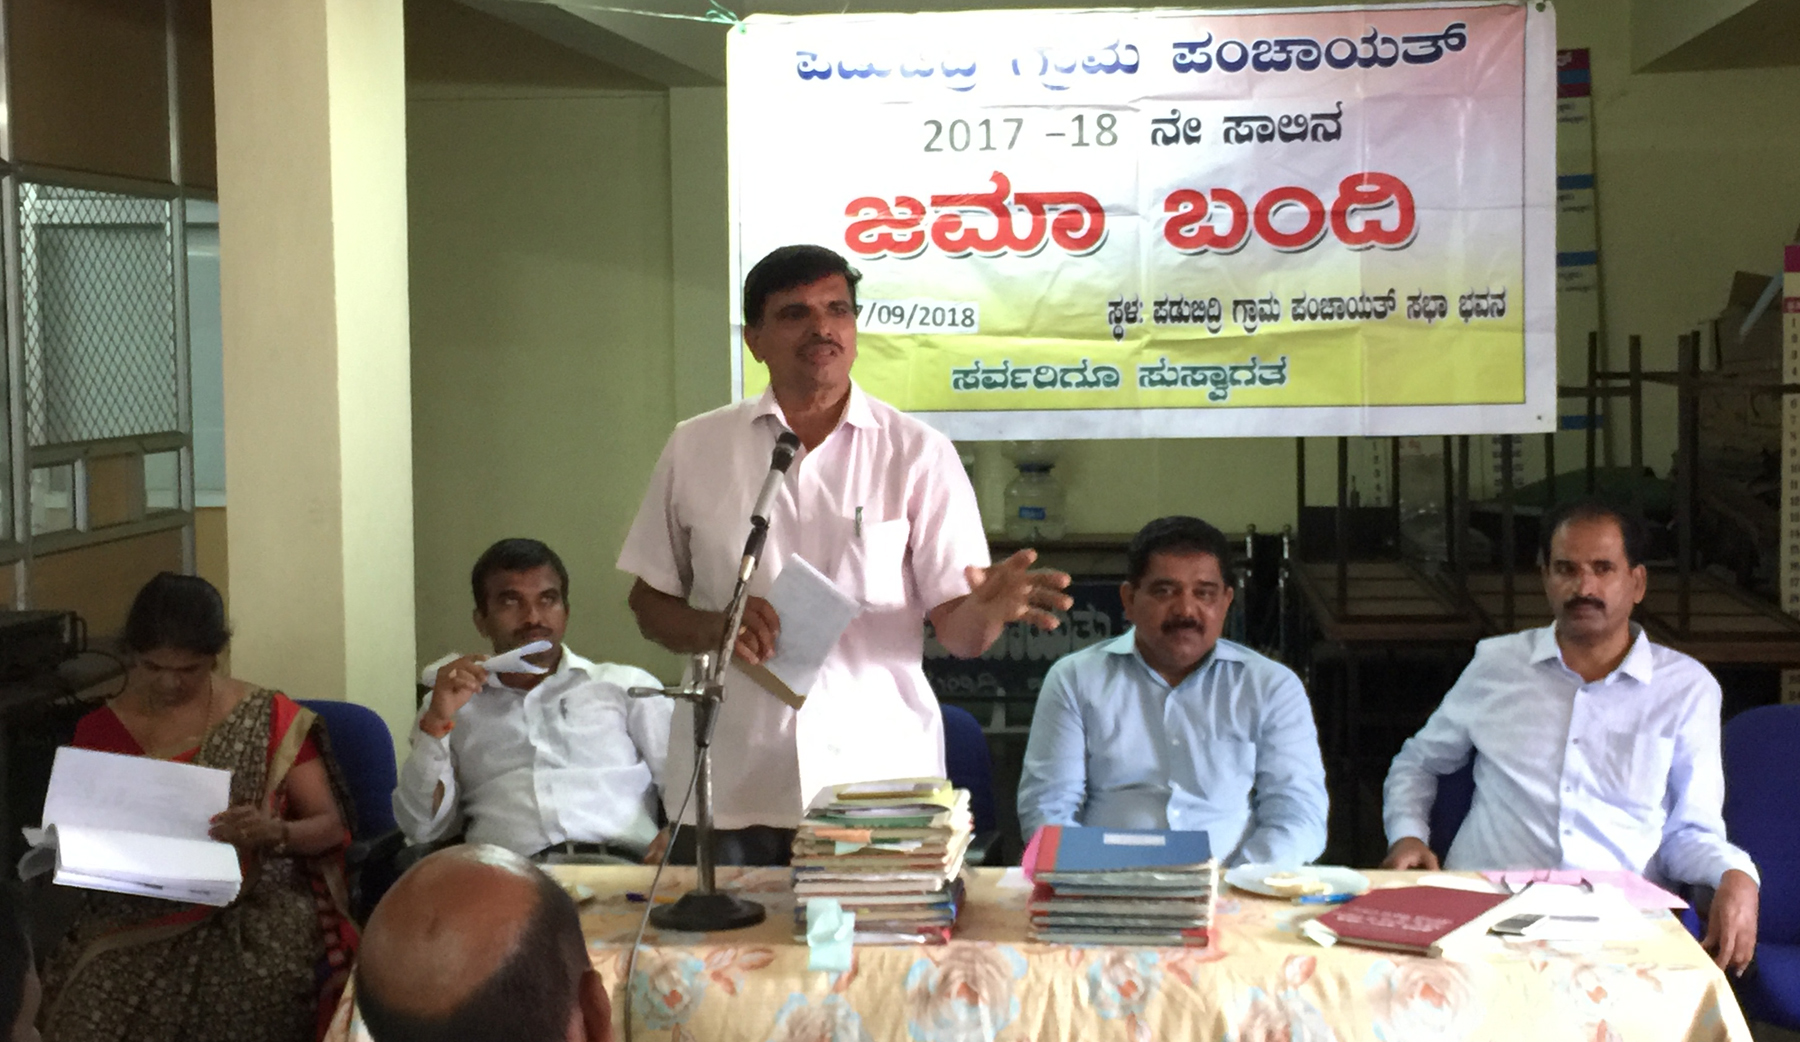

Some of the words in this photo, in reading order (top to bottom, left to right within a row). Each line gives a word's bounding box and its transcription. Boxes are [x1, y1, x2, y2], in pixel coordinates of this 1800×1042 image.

[1172, 22, 1468, 74] ಪಂಚಾಯತ್
[923, 117, 1024, 152] 2017
[1151, 108, 1202, 146] ನೇ
[1222, 101, 1343, 144] ಸಾಲಿನ
[844, 170, 1109, 260] ಜಮಾ
[1163, 171, 1418, 256] ಬಂದಿ
[1232, 290, 1281, 334] ಗ್ರಾಮ
[1291, 288, 1396, 322] ಪಂಚಾಯತ್
[952, 361, 1120, 390] ಸರ್ವರಿಗೂ
[1139, 356, 1287, 400] ಸುಸ್ವಾಗತ
